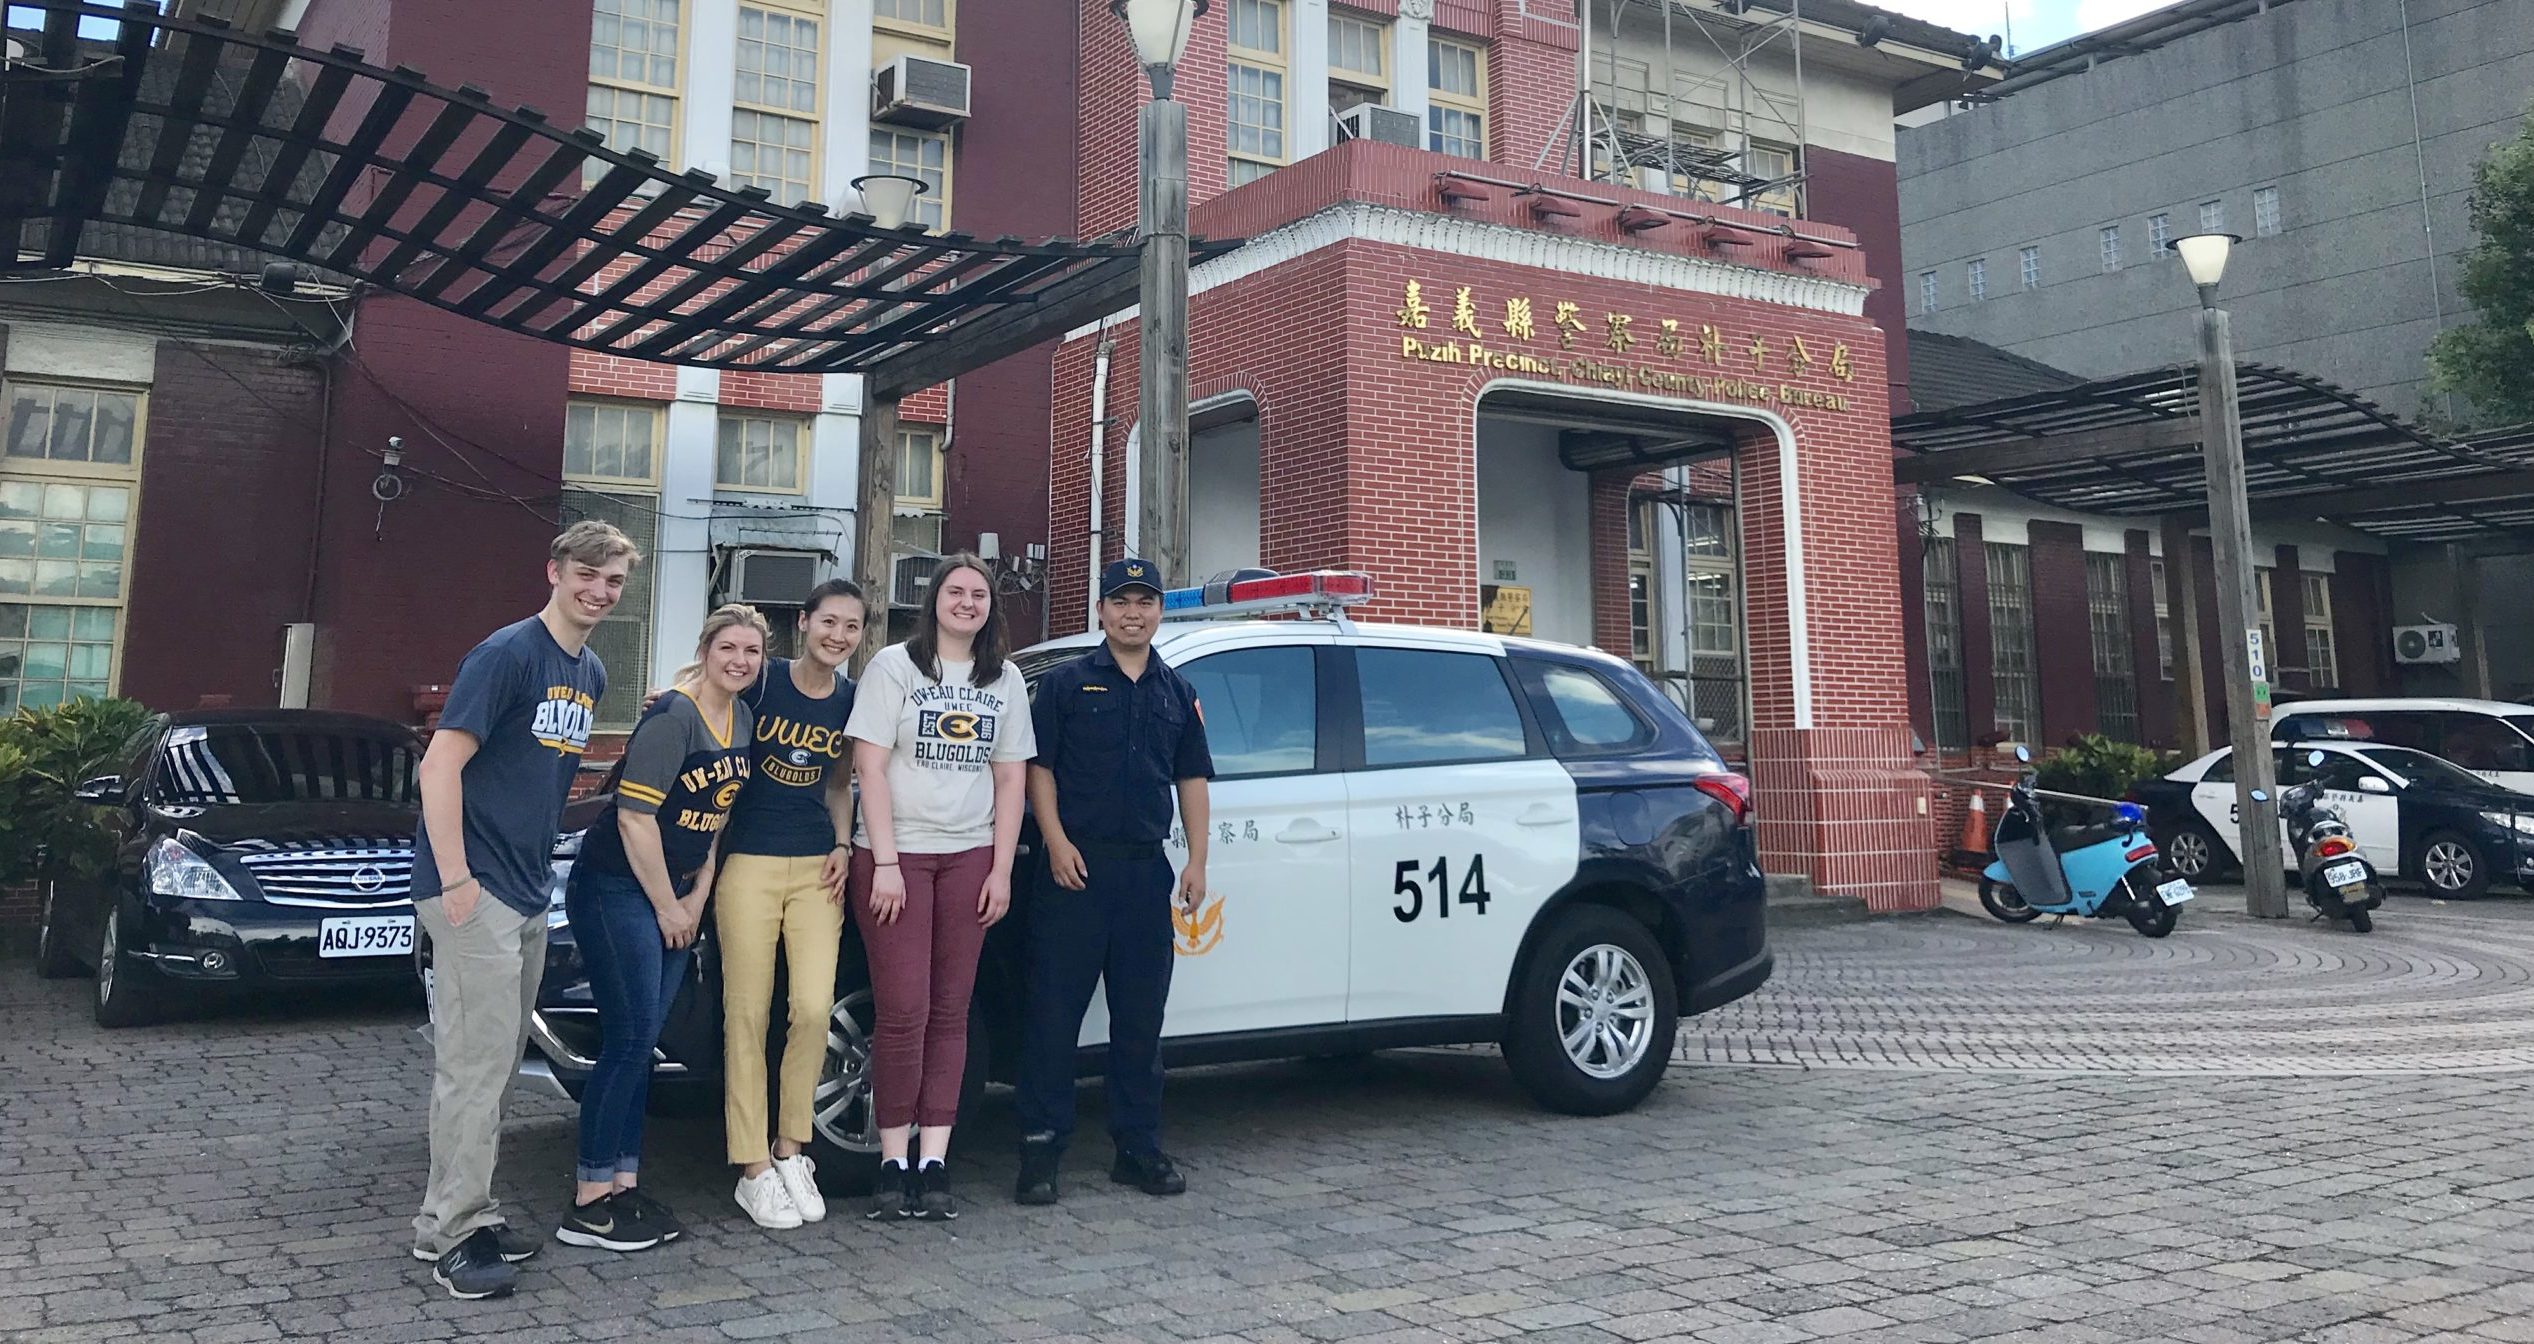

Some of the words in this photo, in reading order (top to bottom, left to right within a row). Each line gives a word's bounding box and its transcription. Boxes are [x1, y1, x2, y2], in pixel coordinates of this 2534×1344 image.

[1402, 336, 1461, 363] Puzih
[1469, 344, 1561, 379] Precinct,
[1569, 355, 1630, 385] Chiayi
[1638, 365, 1706, 397] County
[1713, 376, 1770, 400] Police
[1779, 384, 1849, 412] Bureau
[944, 702, 973, 712] UWEC
[959, 686, 1004, 713] CLAIRE
[756, 715, 843, 759] UWEC
[915, 741, 991, 764] BLUGOLDS
[767, 761, 816, 783] BLUGOLDS
[1395, 802, 1475, 830] 朴子分局
[1393, 853, 1491, 923] 514
[322, 925, 412, 951] AQJ-9373
